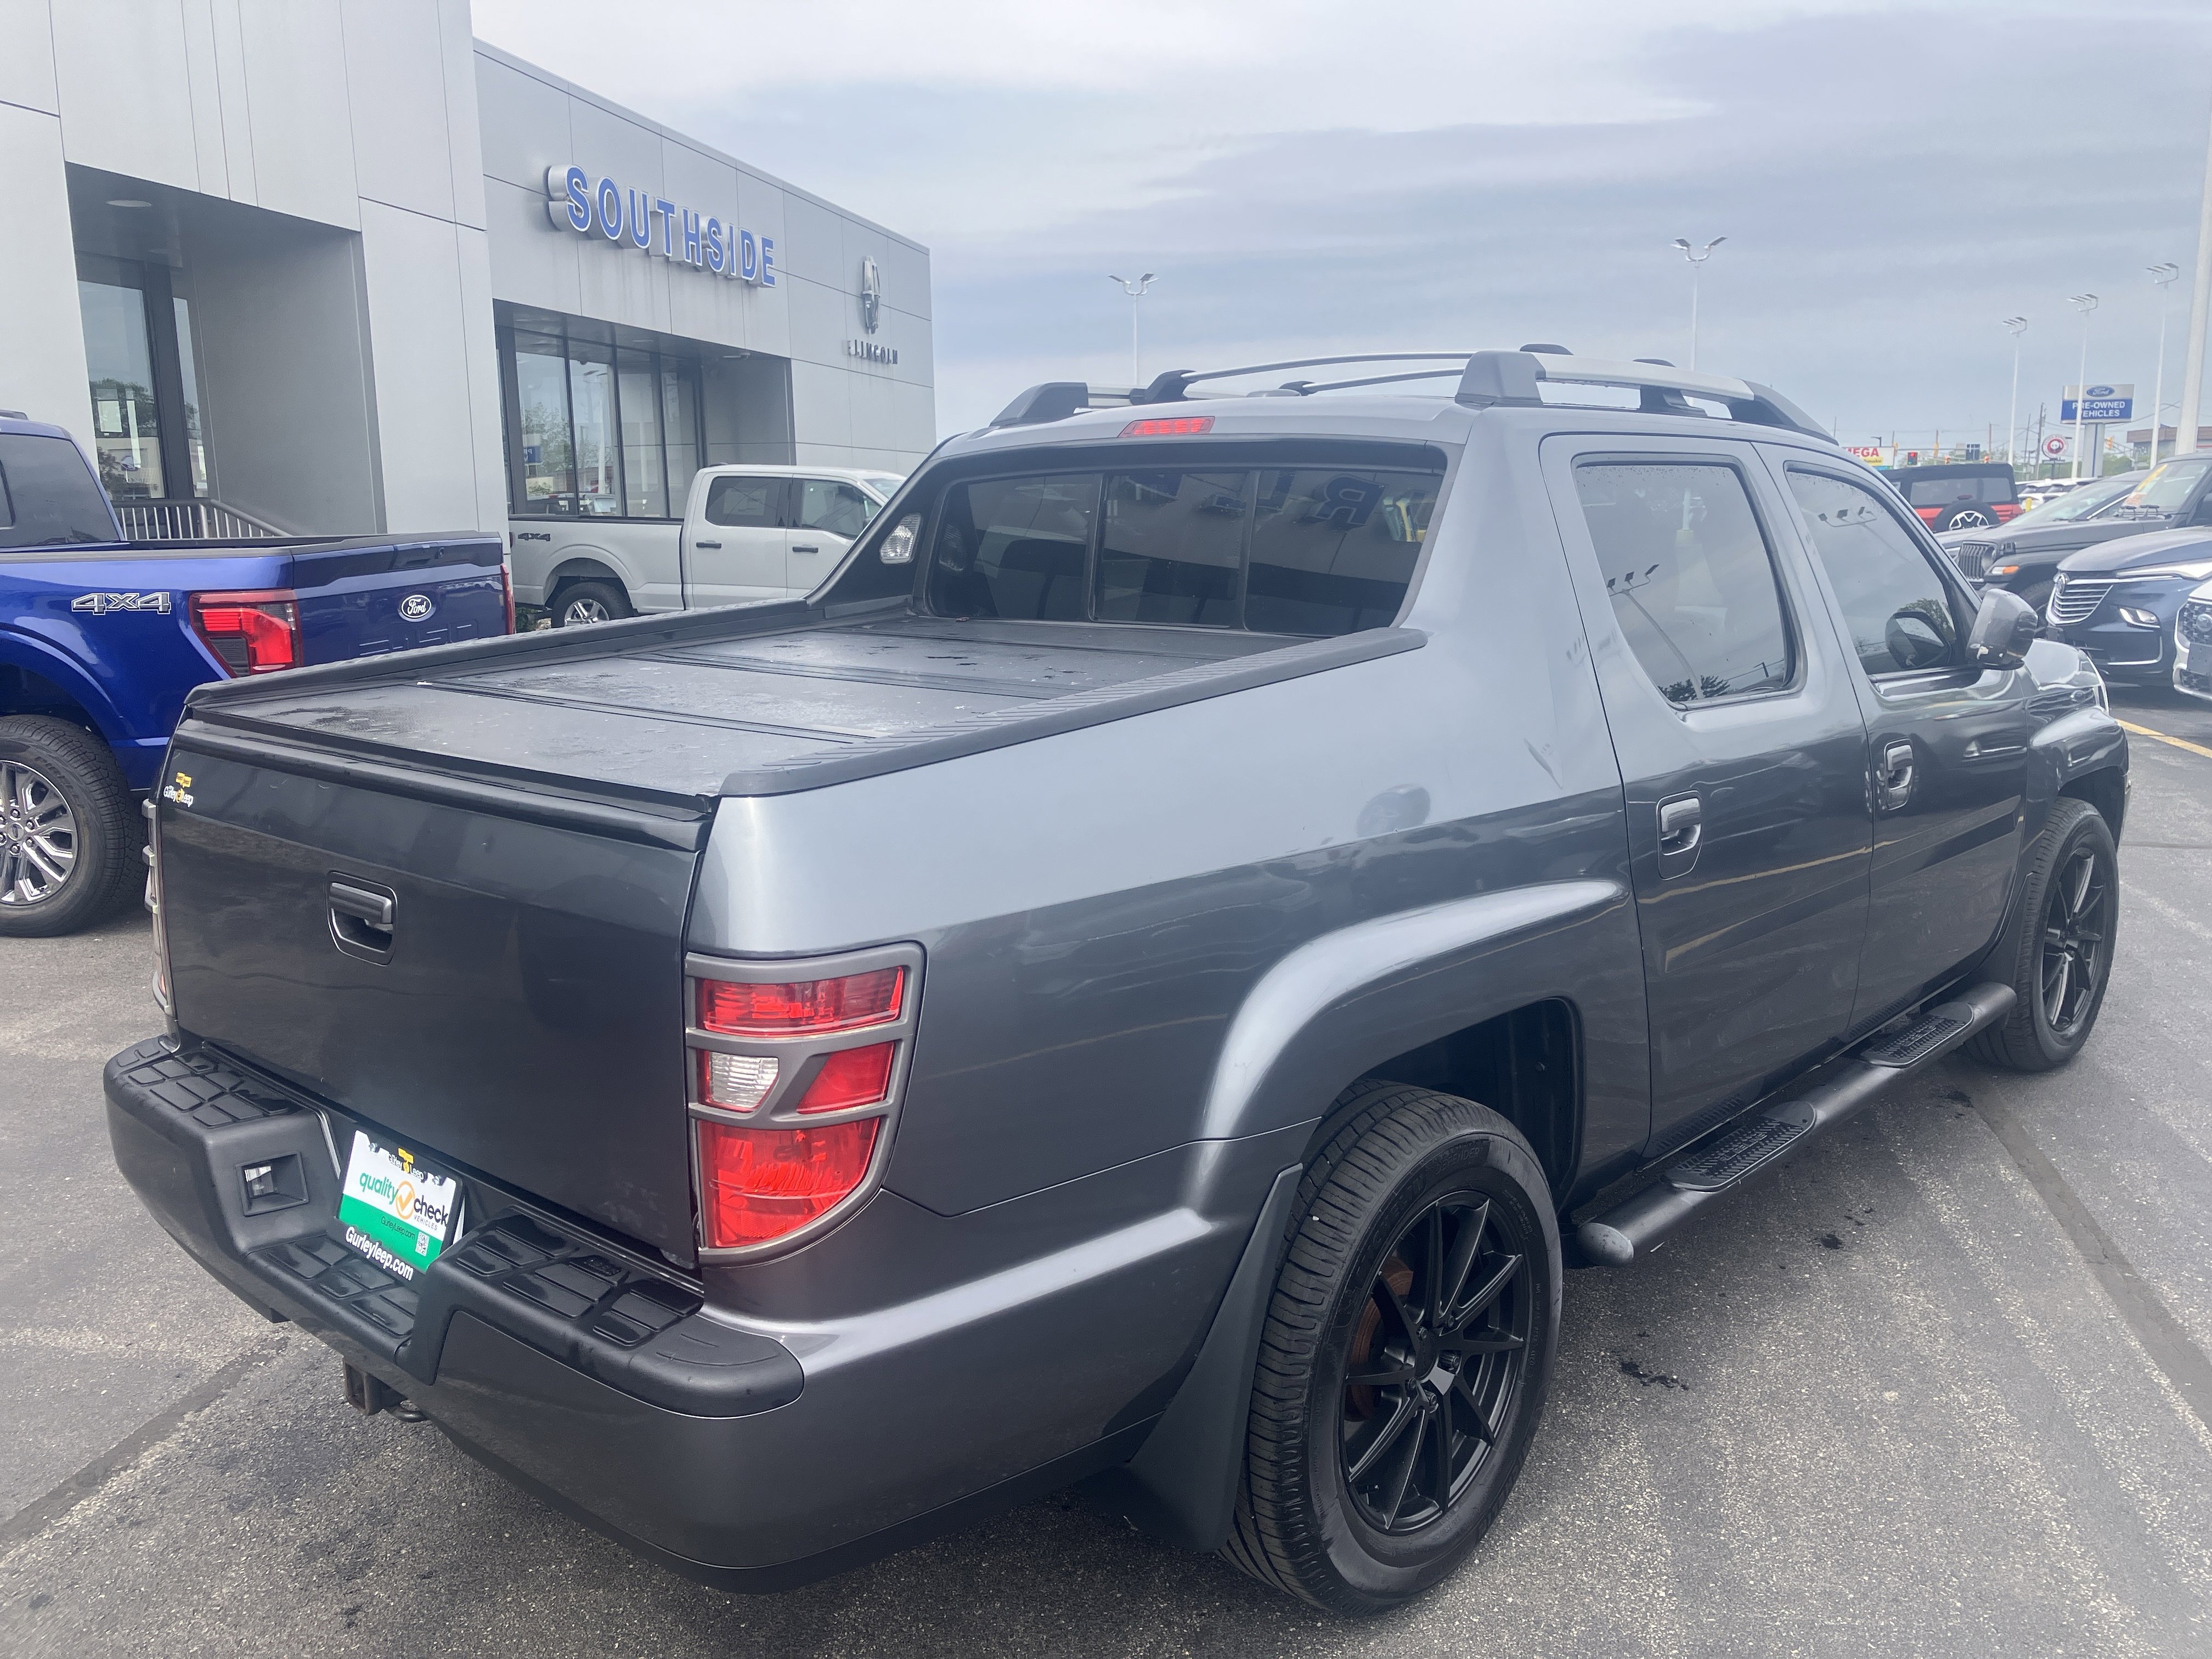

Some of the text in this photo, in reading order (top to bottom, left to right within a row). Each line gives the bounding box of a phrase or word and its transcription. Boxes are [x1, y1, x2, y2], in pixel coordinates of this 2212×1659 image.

[564, 165, 776, 287] SOUTHSIDE
[854, 339, 898, 365] LINCOLN
[2092, 387, 2111, 396] Ford
[2083, 409, 2120, 417] EHICLES
[407, 598, 426, 615] Ford
[359, 1172, 399, 1205] quality
[414, 1194, 449, 1227] check
[414, 1214, 438, 1231] VEHICLES
[345, 1226, 414, 1281] Gurleyleep.com
